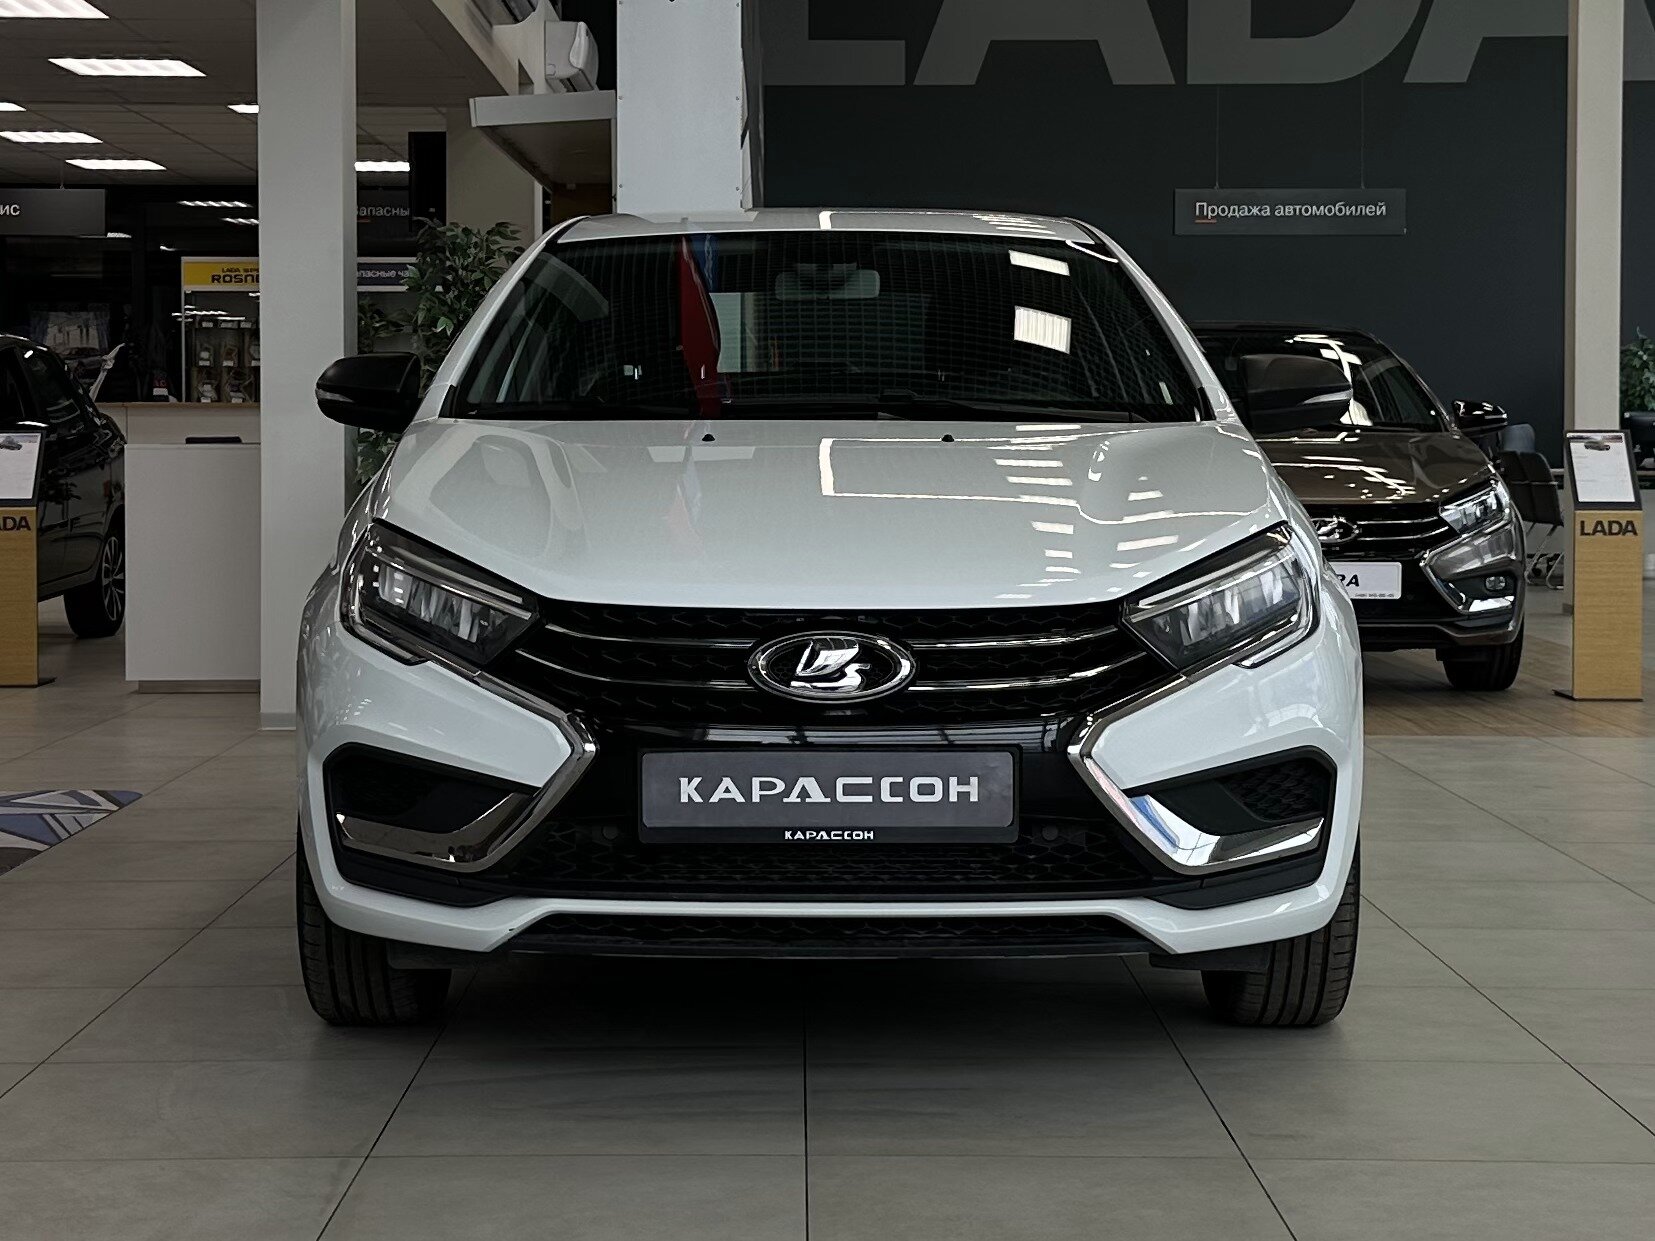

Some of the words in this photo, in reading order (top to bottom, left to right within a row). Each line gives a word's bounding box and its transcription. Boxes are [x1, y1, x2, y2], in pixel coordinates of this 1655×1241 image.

[357, 206, 410, 217] апасны
[1195, 201, 1270, 219] Продажа
[1274, 201, 1387, 216] автомобилей
[0, 516, 31, 531] DA
[1580, 520, 1638, 536] LADA
